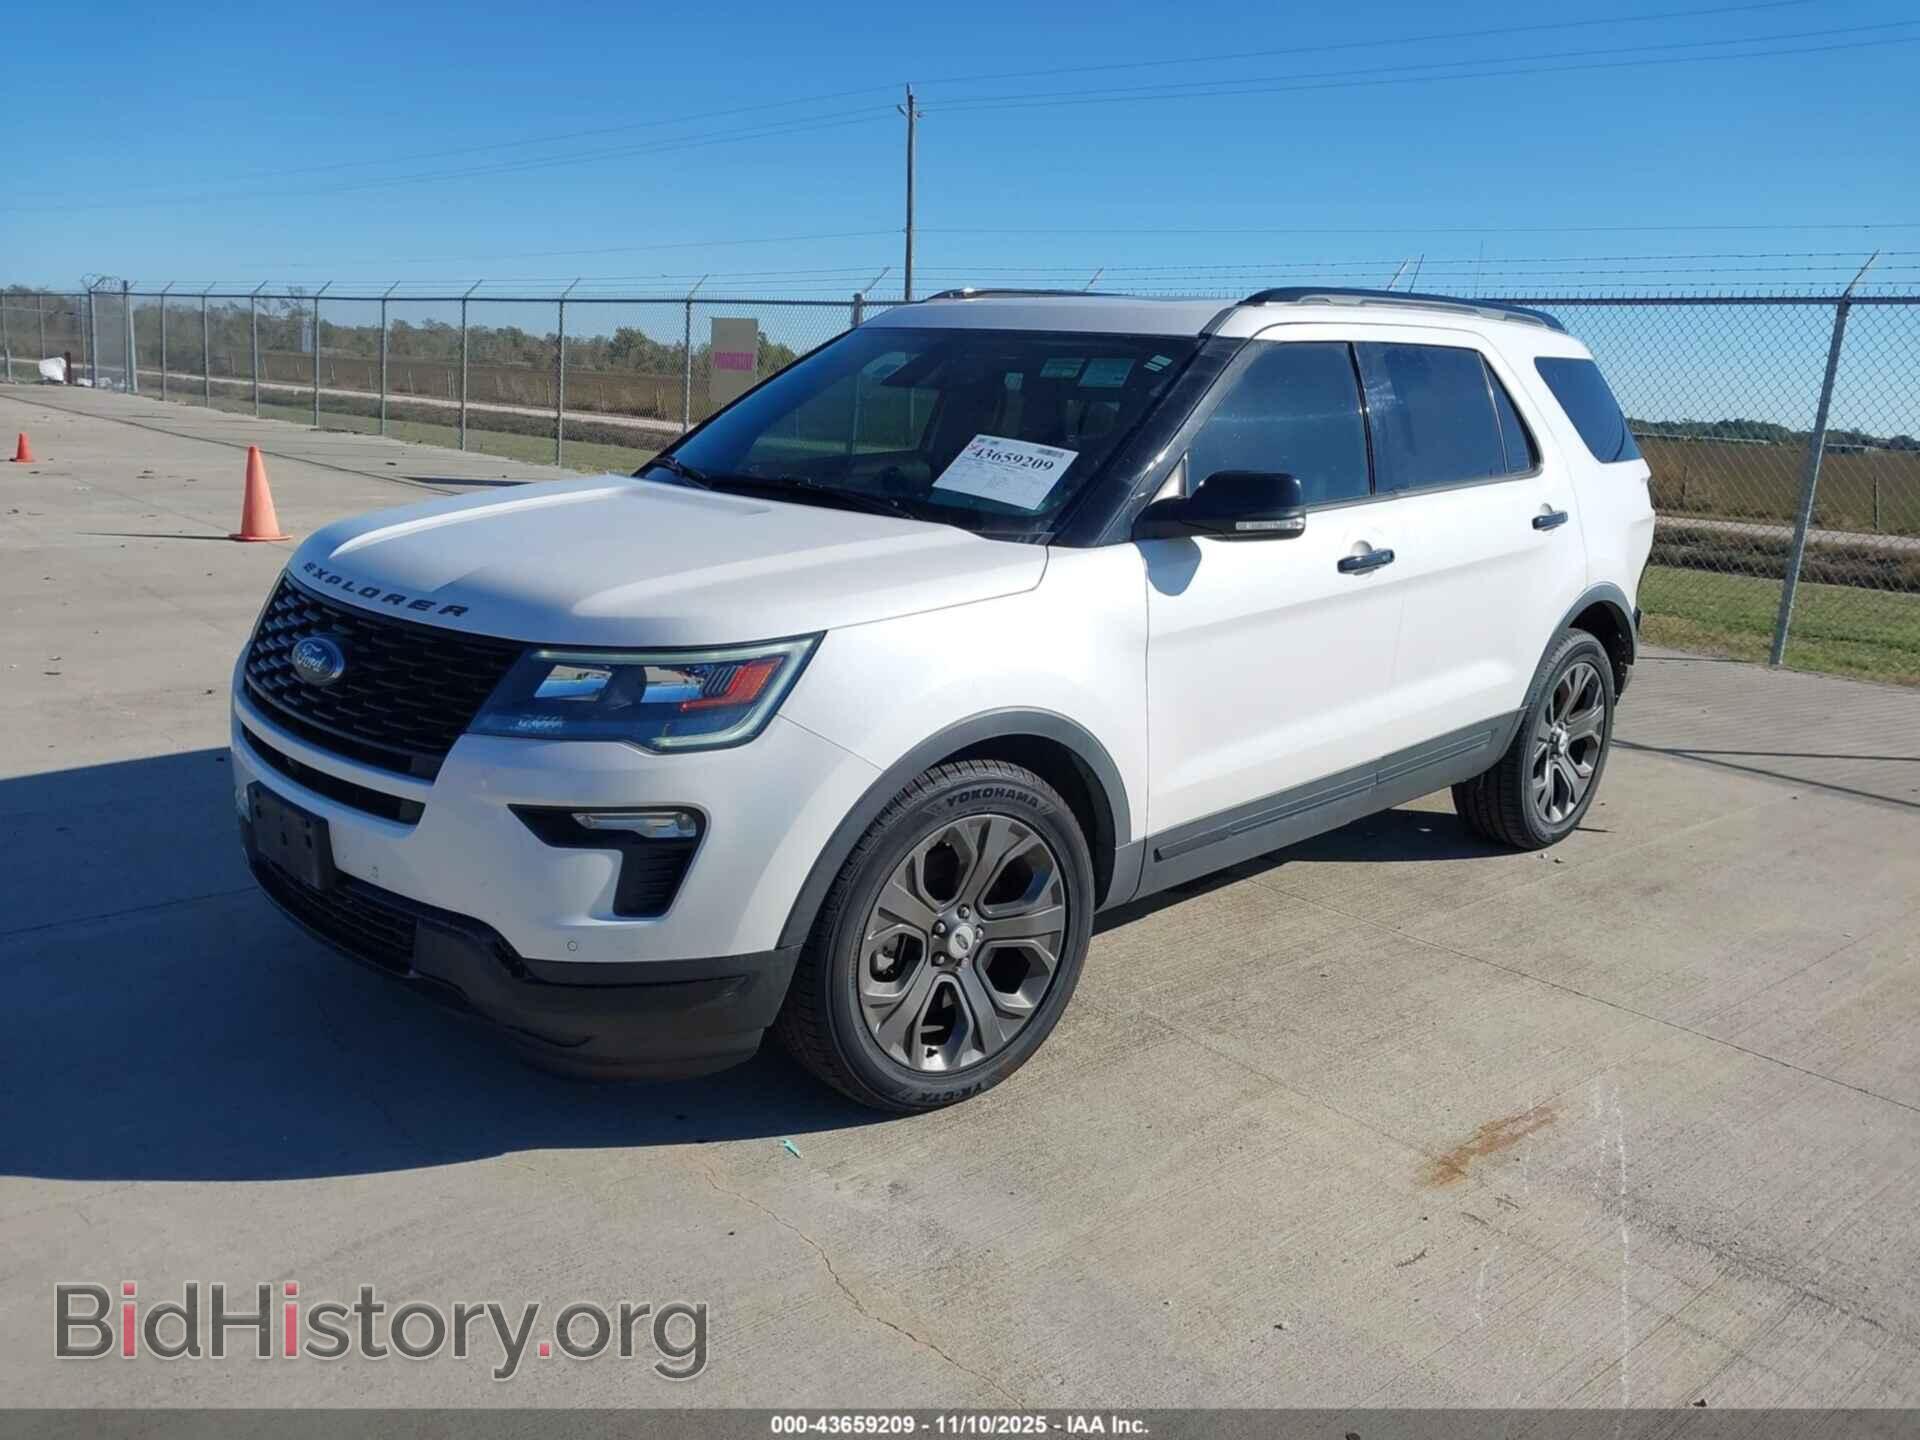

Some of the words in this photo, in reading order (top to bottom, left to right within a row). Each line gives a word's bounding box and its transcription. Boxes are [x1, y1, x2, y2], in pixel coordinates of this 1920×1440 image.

[972, 448, 1054, 472] 43659209
[303, 561, 469, 617] EXPLORER
[297, 643, 327, 673] Ford
[946, 787, 1039, 808] YOKOHAMA
